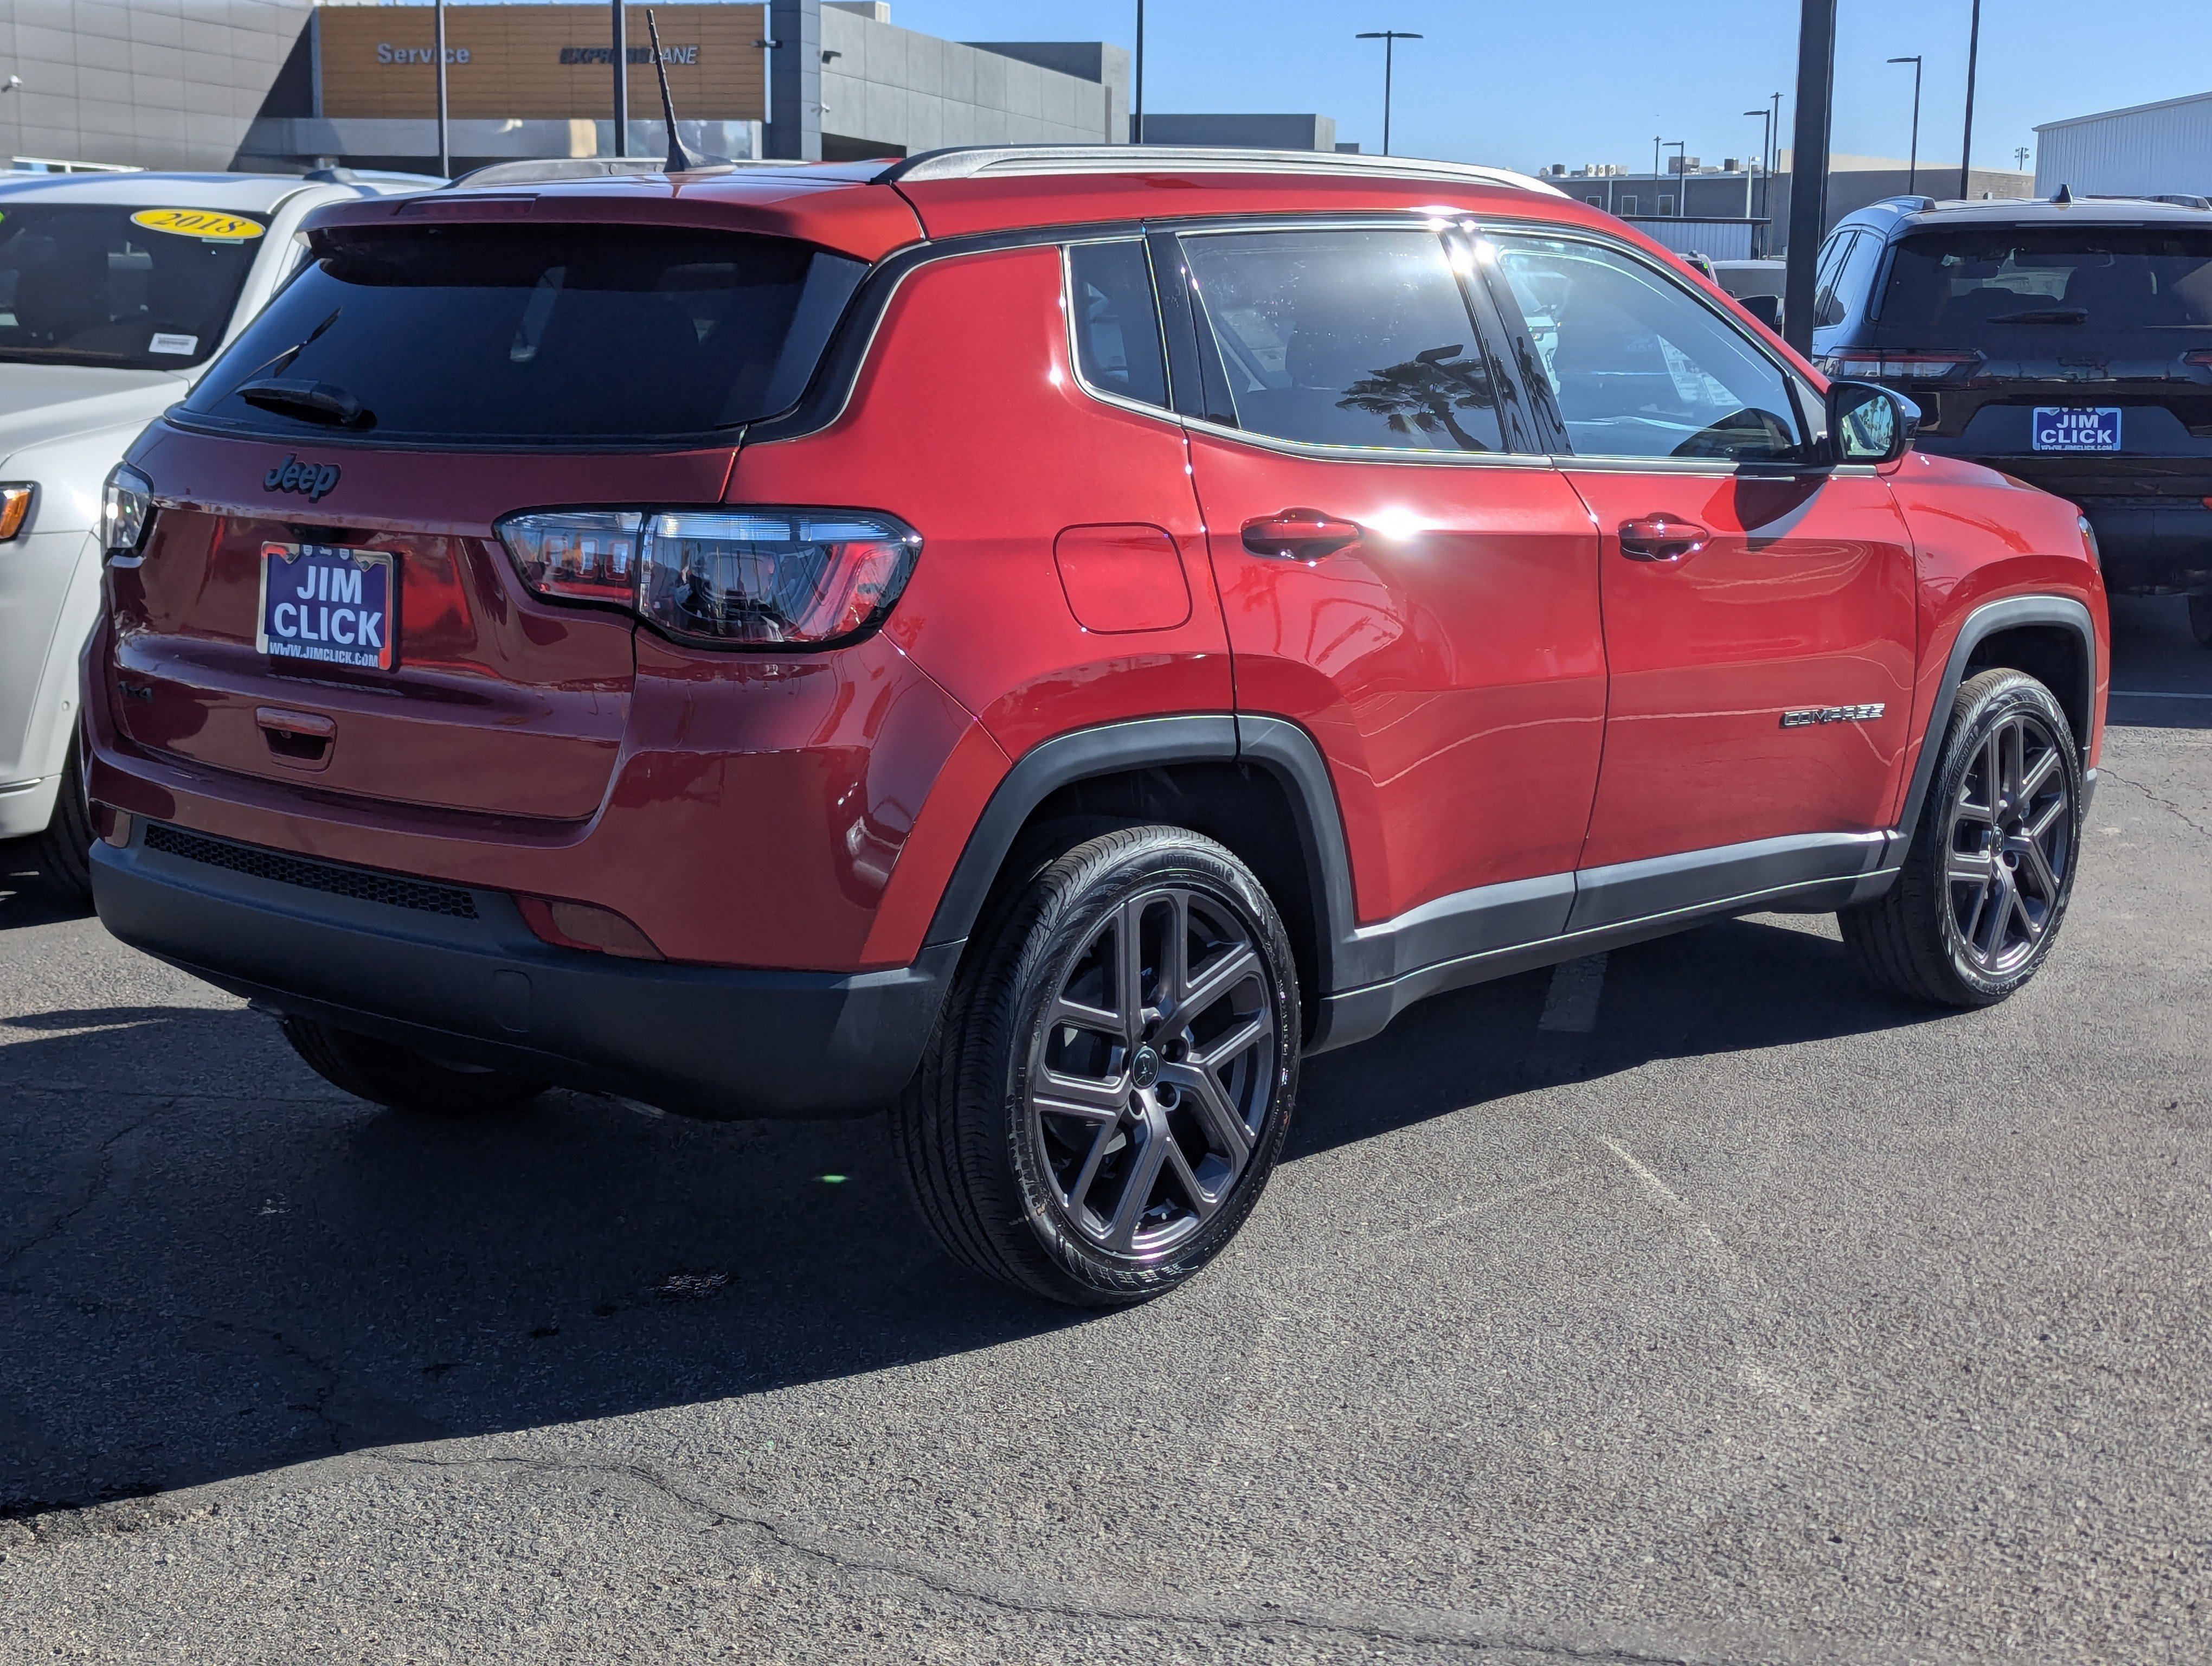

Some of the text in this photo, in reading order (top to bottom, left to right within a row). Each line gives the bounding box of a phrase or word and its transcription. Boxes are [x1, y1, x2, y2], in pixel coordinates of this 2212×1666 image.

[151, 213, 247, 234] 2018
[2056, 414, 2099, 428] JIM
[2041, 430, 2112, 444] CLICK
[263, 453, 342, 503] Jeep
[297, 566, 362, 605] JIM
[274, 603, 383, 648] CLICK
[269, 642, 379, 668] WWW.JIMCLICK.COM
[1783, 703, 1885, 726] COMPASS
